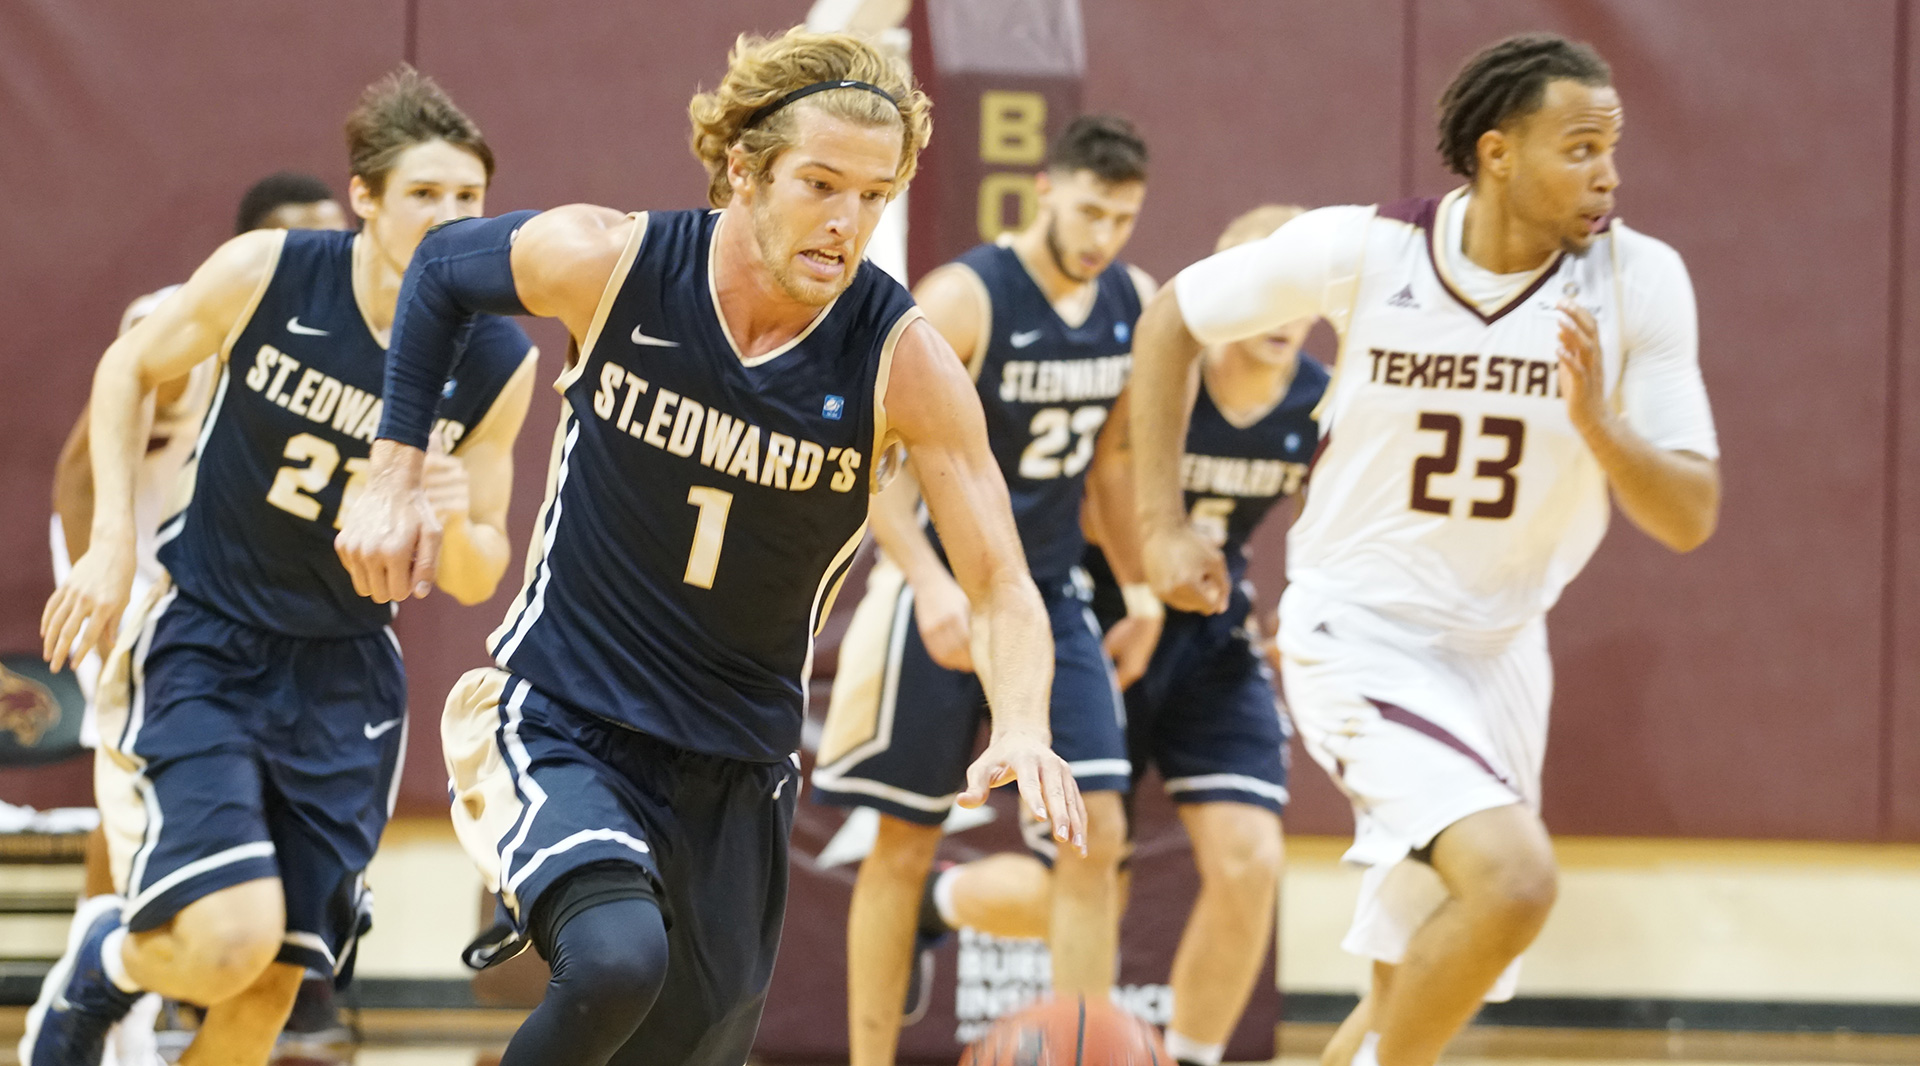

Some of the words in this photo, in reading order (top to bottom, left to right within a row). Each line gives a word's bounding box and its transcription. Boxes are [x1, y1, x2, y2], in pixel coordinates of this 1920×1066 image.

[1369, 348, 1479, 390] TEXAS
[594, 361, 862, 493] ST.EDWARD'S
[1409, 411, 1526, 521] 23
[683, 485, 734, 590] 1
